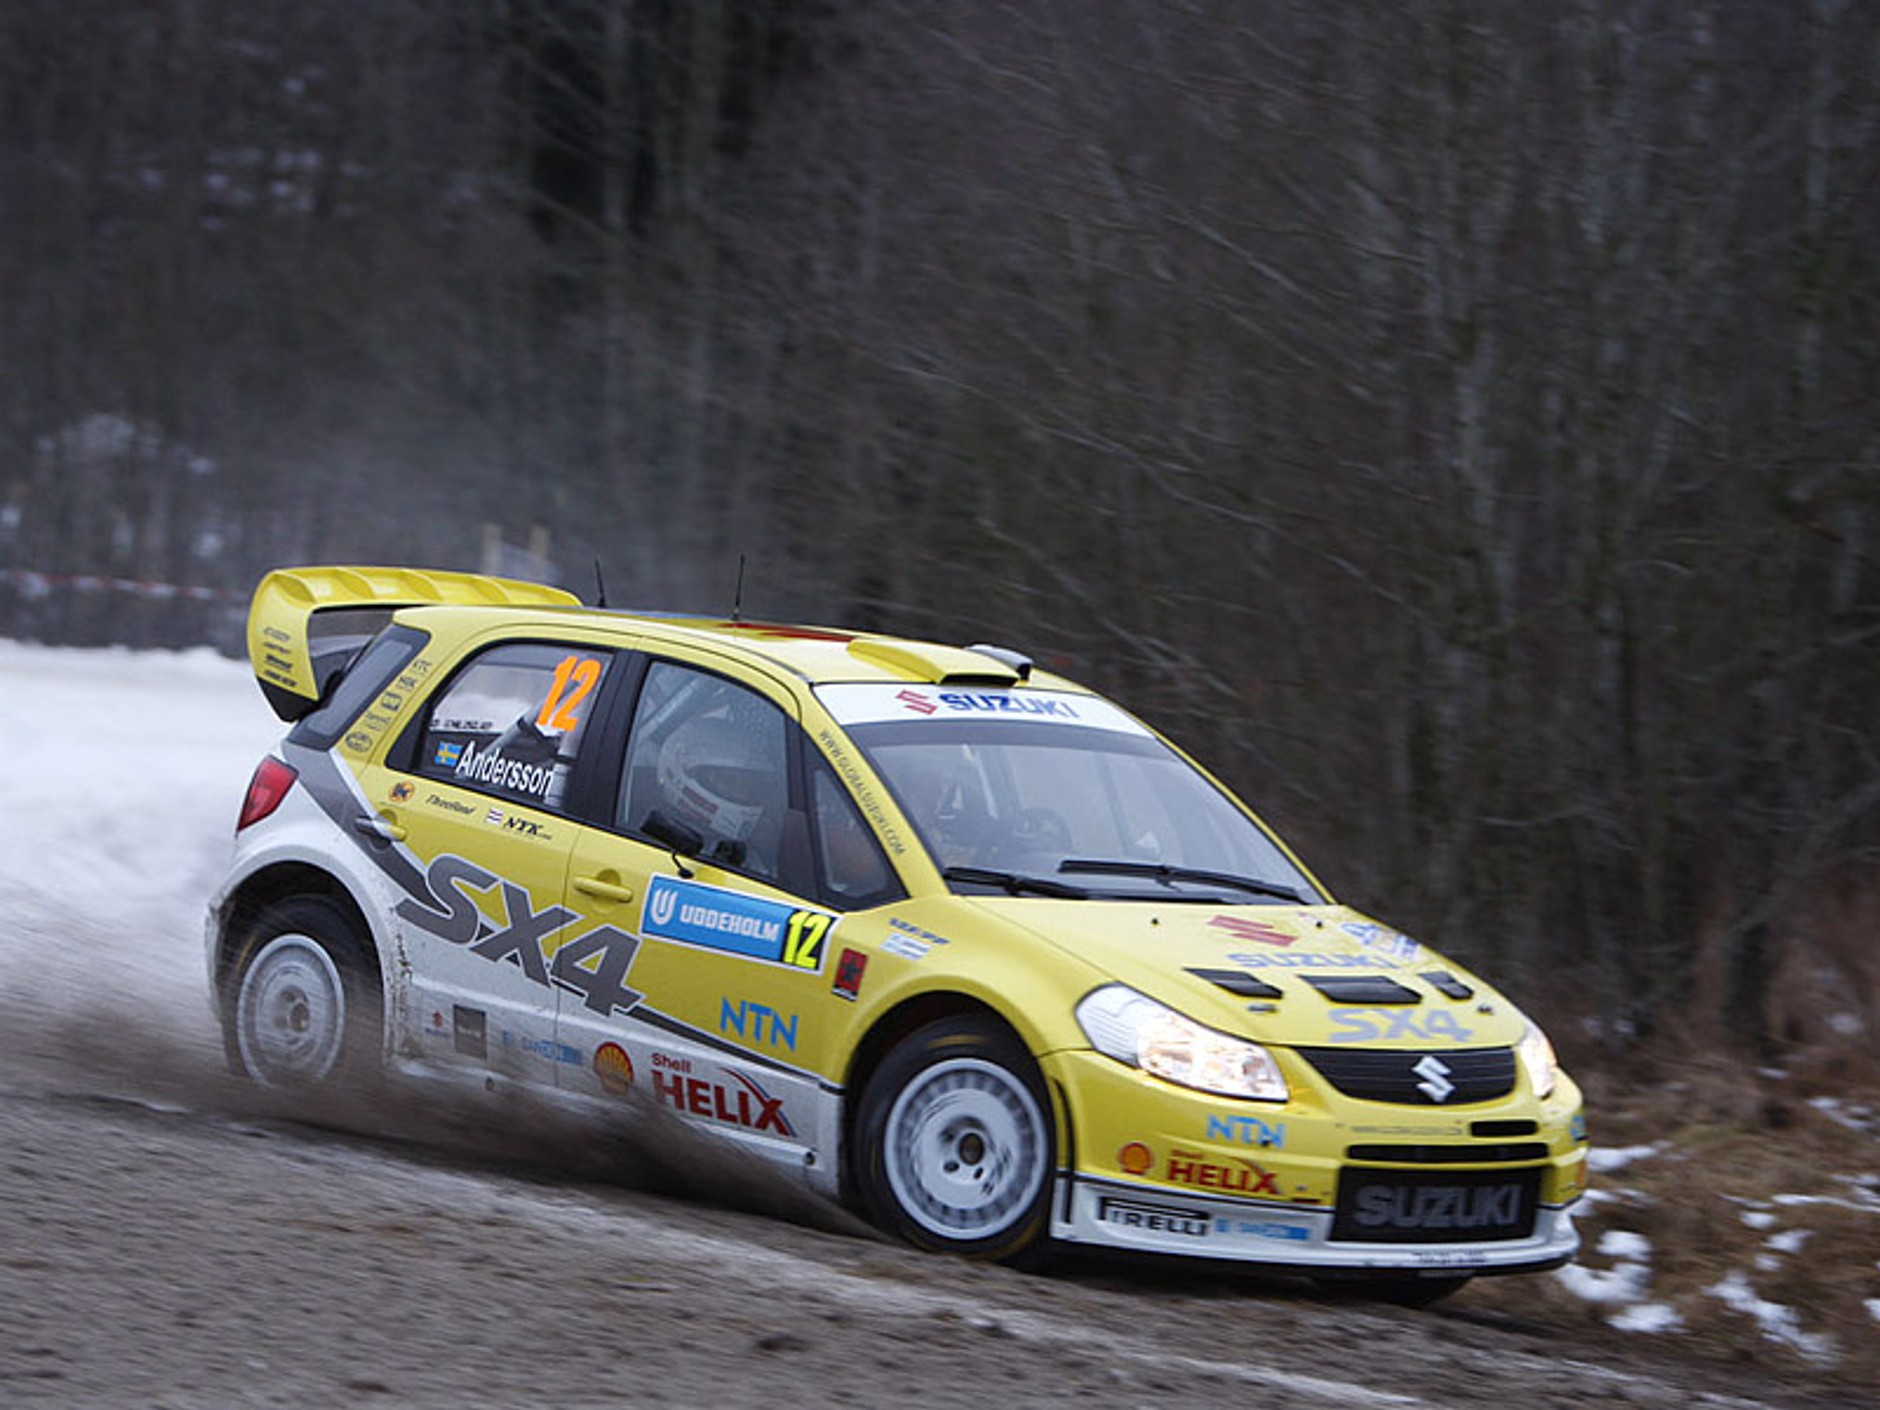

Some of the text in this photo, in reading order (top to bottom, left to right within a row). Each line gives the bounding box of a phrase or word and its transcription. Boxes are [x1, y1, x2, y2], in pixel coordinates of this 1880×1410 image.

[536, 655, 603, 732] 12
[938, 692, 1080, 718] SUZUKI
[455, 740, 554, 796] Andersson
[394, 853, 646, 1017] SX4
[679, 903, 781, 942] UDDEHOLM
[783, 909, 832, 970] 12
[1226, 952, 1401, 969] SUZUKI
[719, 997, 798, 1052] NTN
[1327, 1007, 1475, 1043] SX4
[651, 1052, 692, 1073] Shell
[650, 1068, 796, 1137] HELIX
[1206, 1113, 1286, 1148] NTN
[1166, 1157, 1281, 1195] HELIX
[1352, 1184, 1523, 1229] SUZUKI
